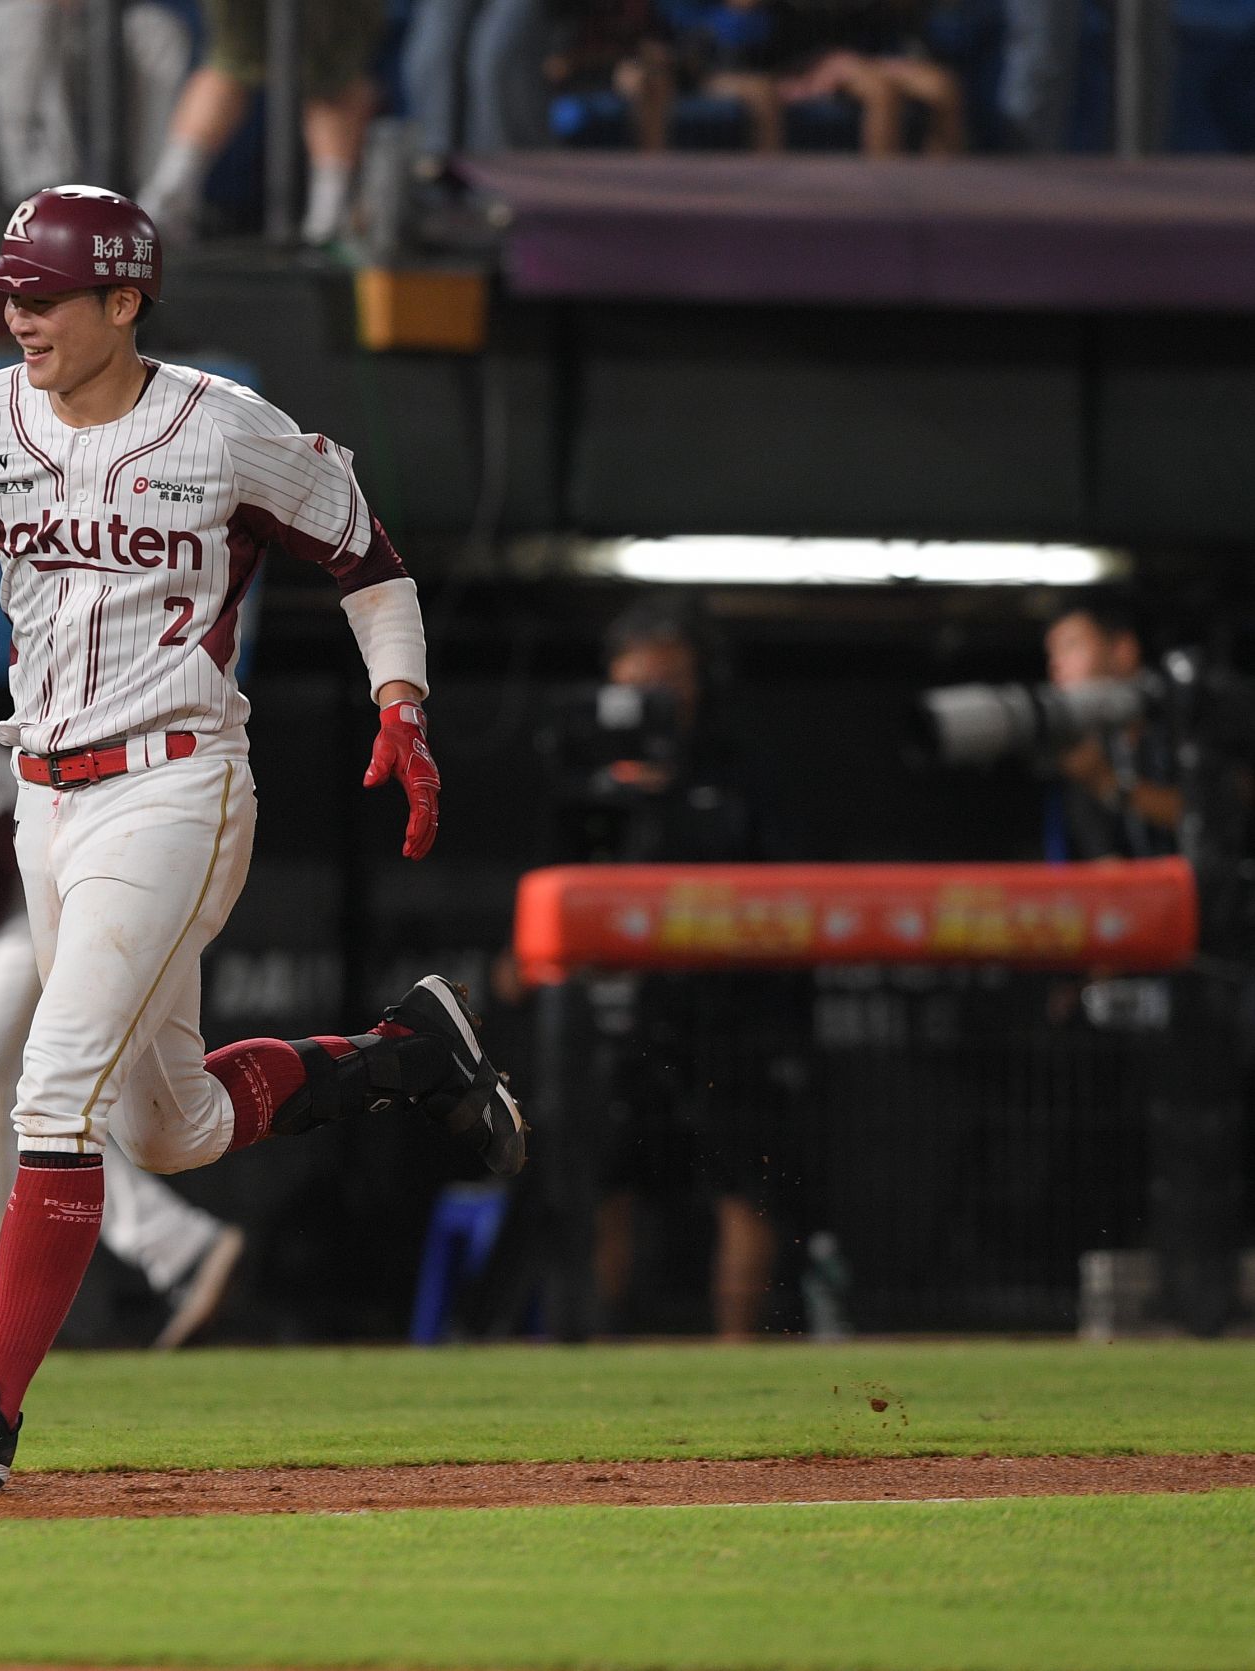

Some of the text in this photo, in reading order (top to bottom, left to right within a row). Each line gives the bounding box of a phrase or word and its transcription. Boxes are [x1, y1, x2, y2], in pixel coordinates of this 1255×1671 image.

[4, 200, 37, 243] R
[149, 479, 205, 495] Global Mall
[158, 595, 195, 648] 2
